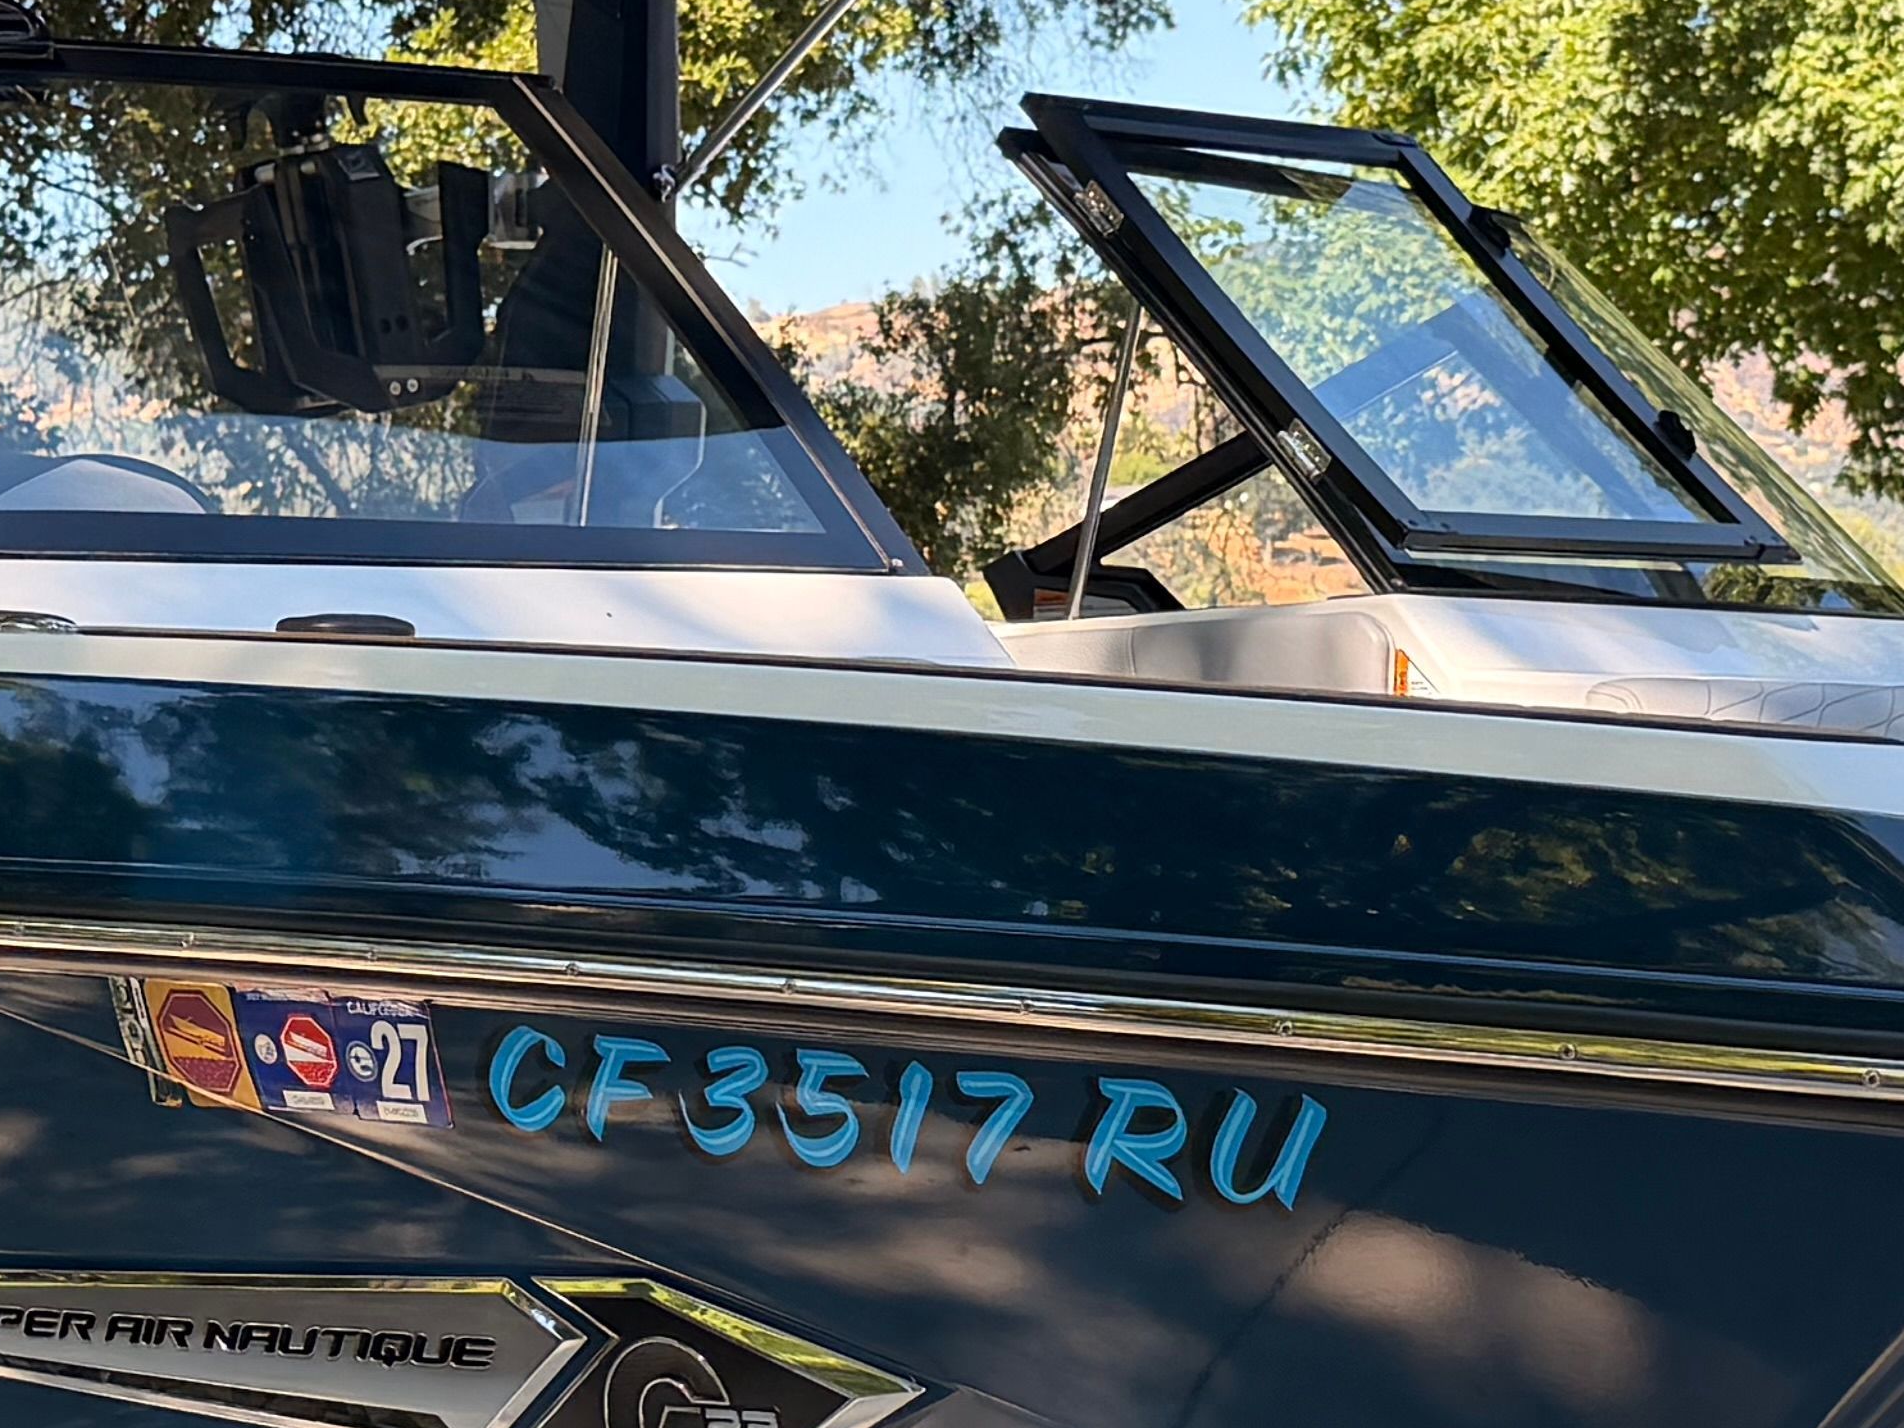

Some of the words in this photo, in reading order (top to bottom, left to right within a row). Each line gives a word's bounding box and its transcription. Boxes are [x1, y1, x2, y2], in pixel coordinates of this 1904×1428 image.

[371, 1021, 430, 1101] 27
[1083, 1075, 1329, 1212] RU
[104, 1312, 191, 1350] AIR
[202, 1320, 498, 1370] NAUTIQUE
